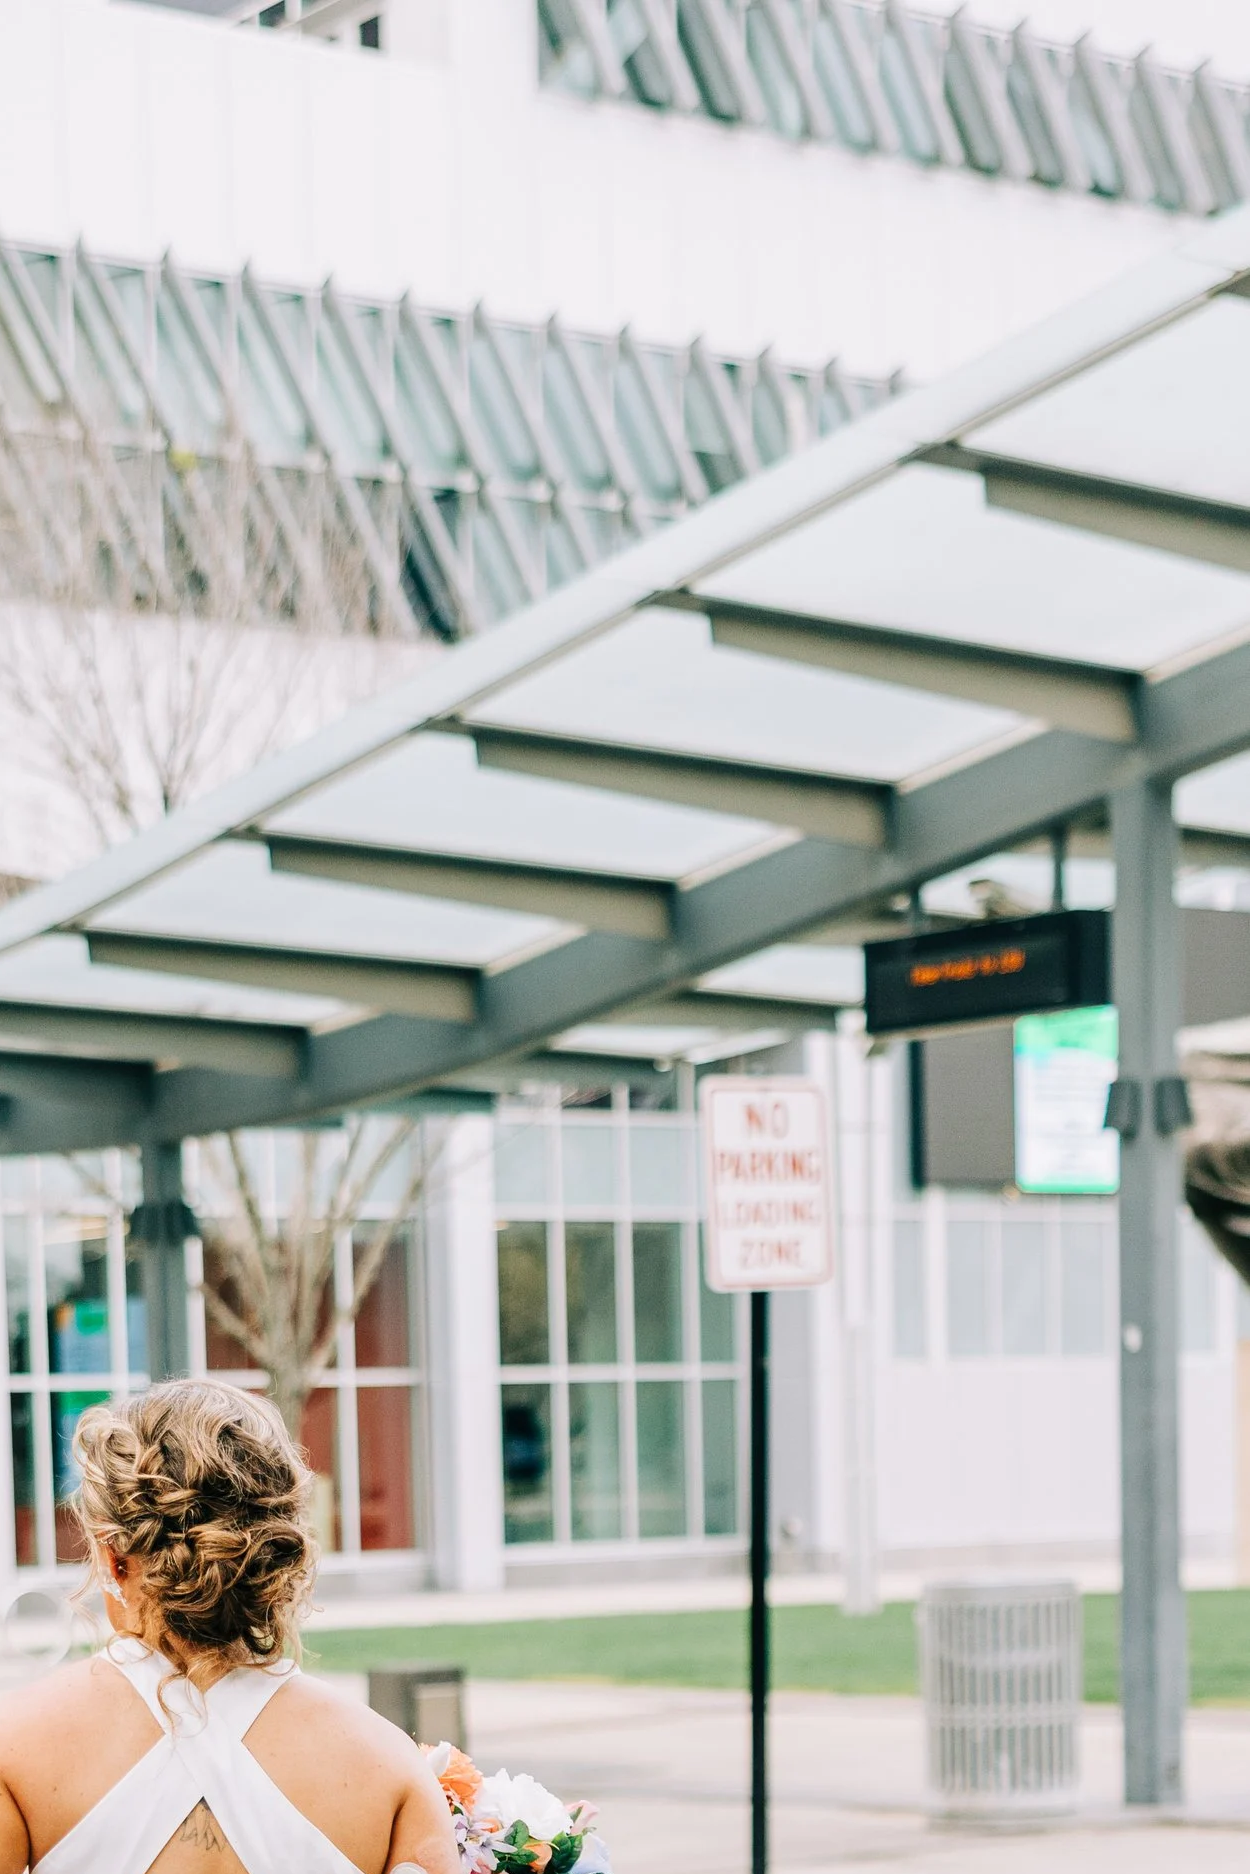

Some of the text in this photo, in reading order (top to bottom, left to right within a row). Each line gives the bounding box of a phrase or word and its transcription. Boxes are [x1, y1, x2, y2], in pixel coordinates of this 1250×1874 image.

[741, 1101, 790, 1139] NO
[717, 1150, 822, 1184] PARKING
[720, 1199, 820, 1230] LOADING
[740, 1239, 803, 1268] ZONE
